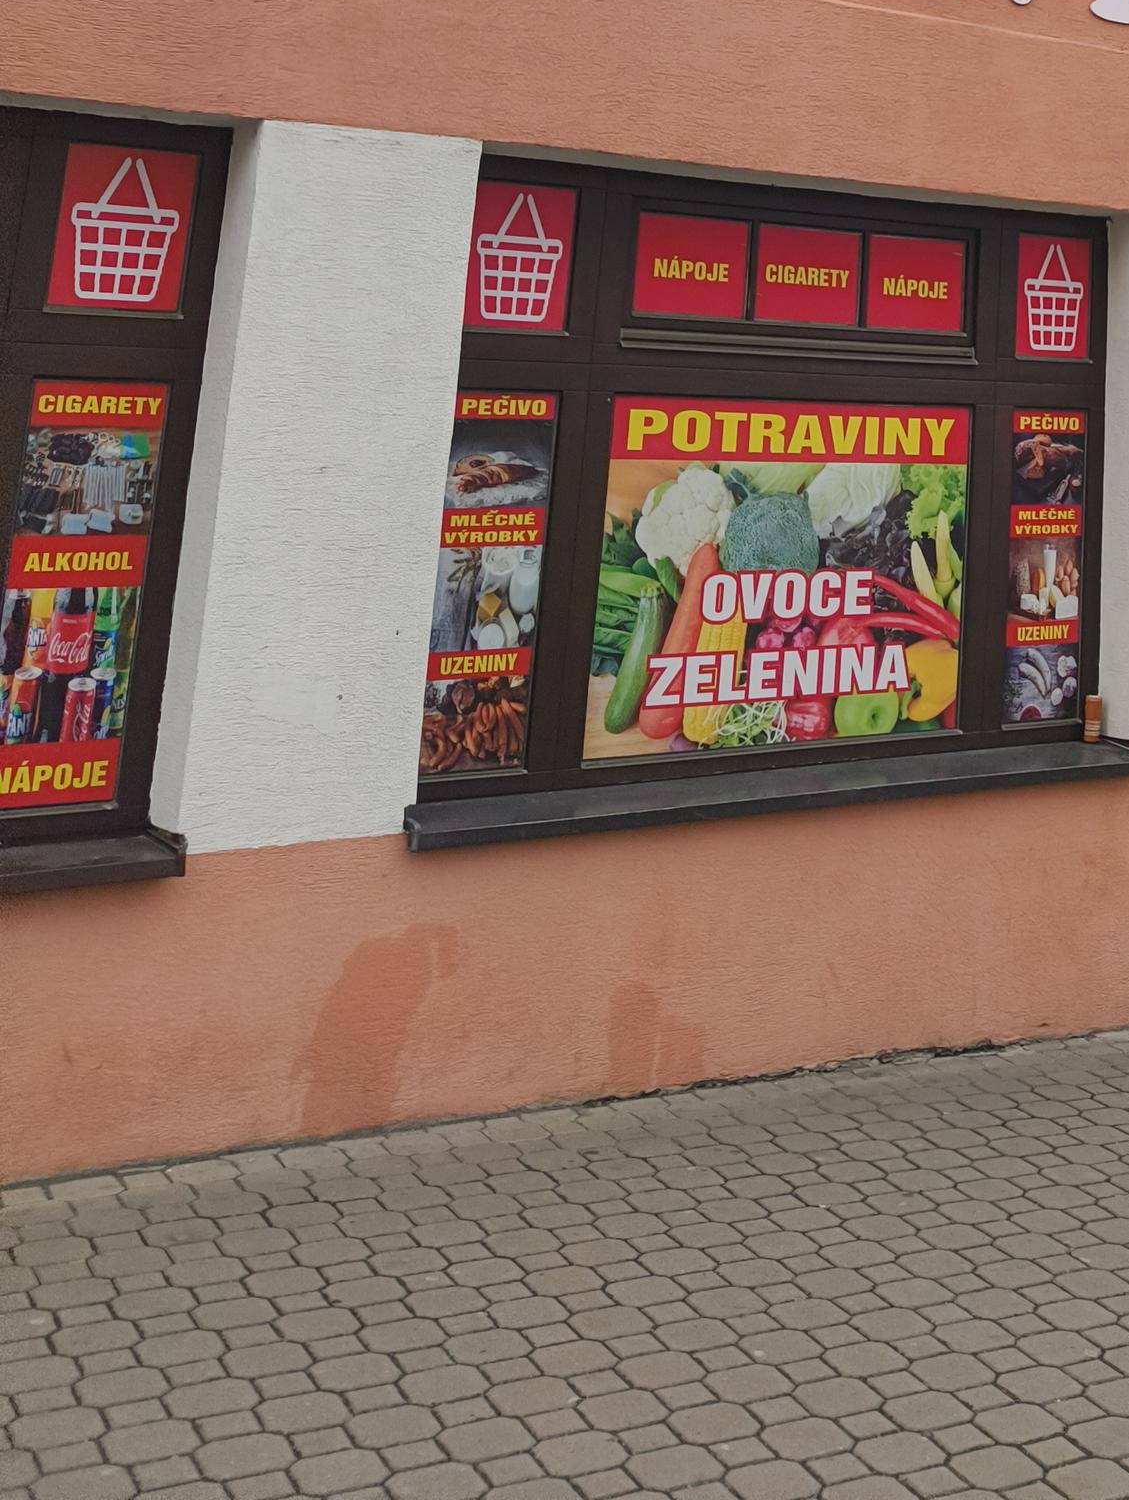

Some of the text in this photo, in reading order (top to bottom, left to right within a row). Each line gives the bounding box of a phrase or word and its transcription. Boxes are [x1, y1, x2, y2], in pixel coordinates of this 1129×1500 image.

[653, 255, 949, 300] NÁPOJE CIGARETY NÁPOJE
[38, 394, 162, 415] CIGARETY
[461, 395, 547, 417] PEČIVO
[626, 408, 956, 456] POTRAVINY
[1019, 413, 1080, 431] PEČIVO
[450, 509, 536, 527] MLÉČNÉ
[1018, 507, 1076, 521] MLÉČNÉ
[444, 529, 539, 545] VÝROBKY
[1015, 521, 1079, 535] VÝROBKY
[23, 552, 133, 572] ALKOHOL
[702, 570, 873, 622] OVOCE
[1017, 624, 1070, 642] UZENINY
[440, 653, 518, 676] UZENINY
[645, 644, 909, 706] ZELENINA
